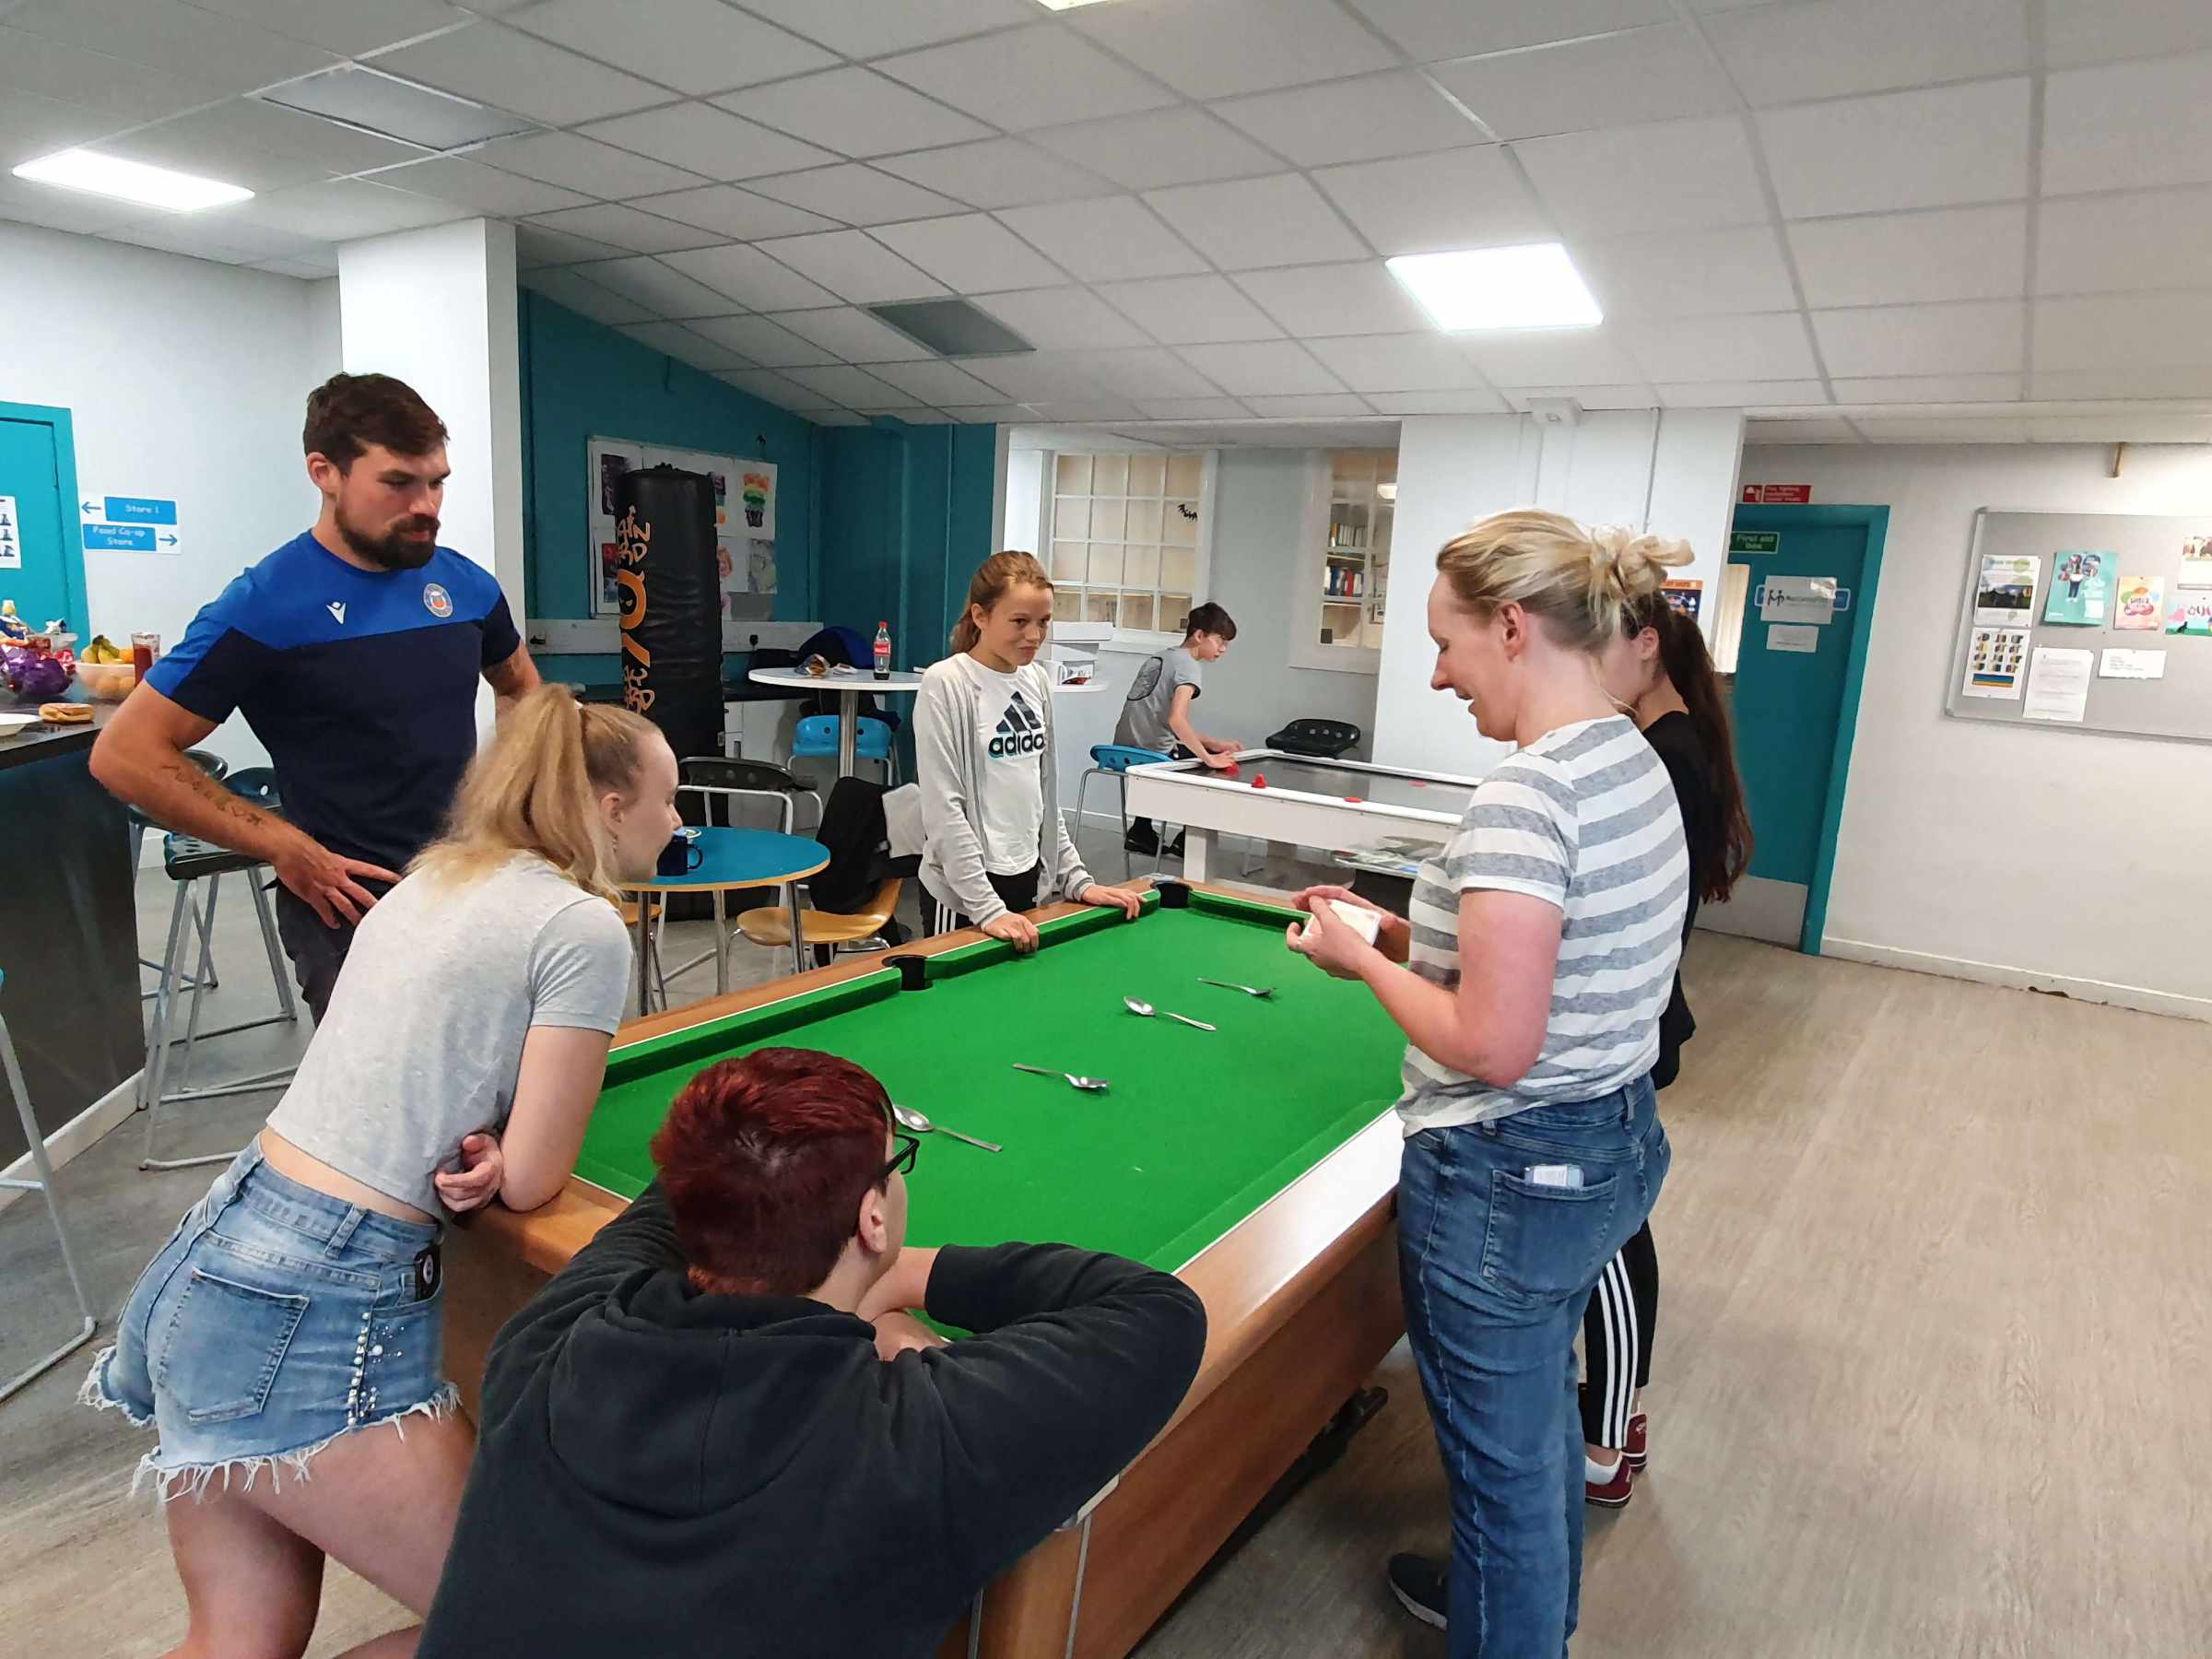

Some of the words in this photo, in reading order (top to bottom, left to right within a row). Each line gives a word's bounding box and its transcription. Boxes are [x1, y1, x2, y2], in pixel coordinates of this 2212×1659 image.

[124, 504, 152, 513] Store
[107, 537, 134, 547] Store
[988, 730, 1045, 758] adida
